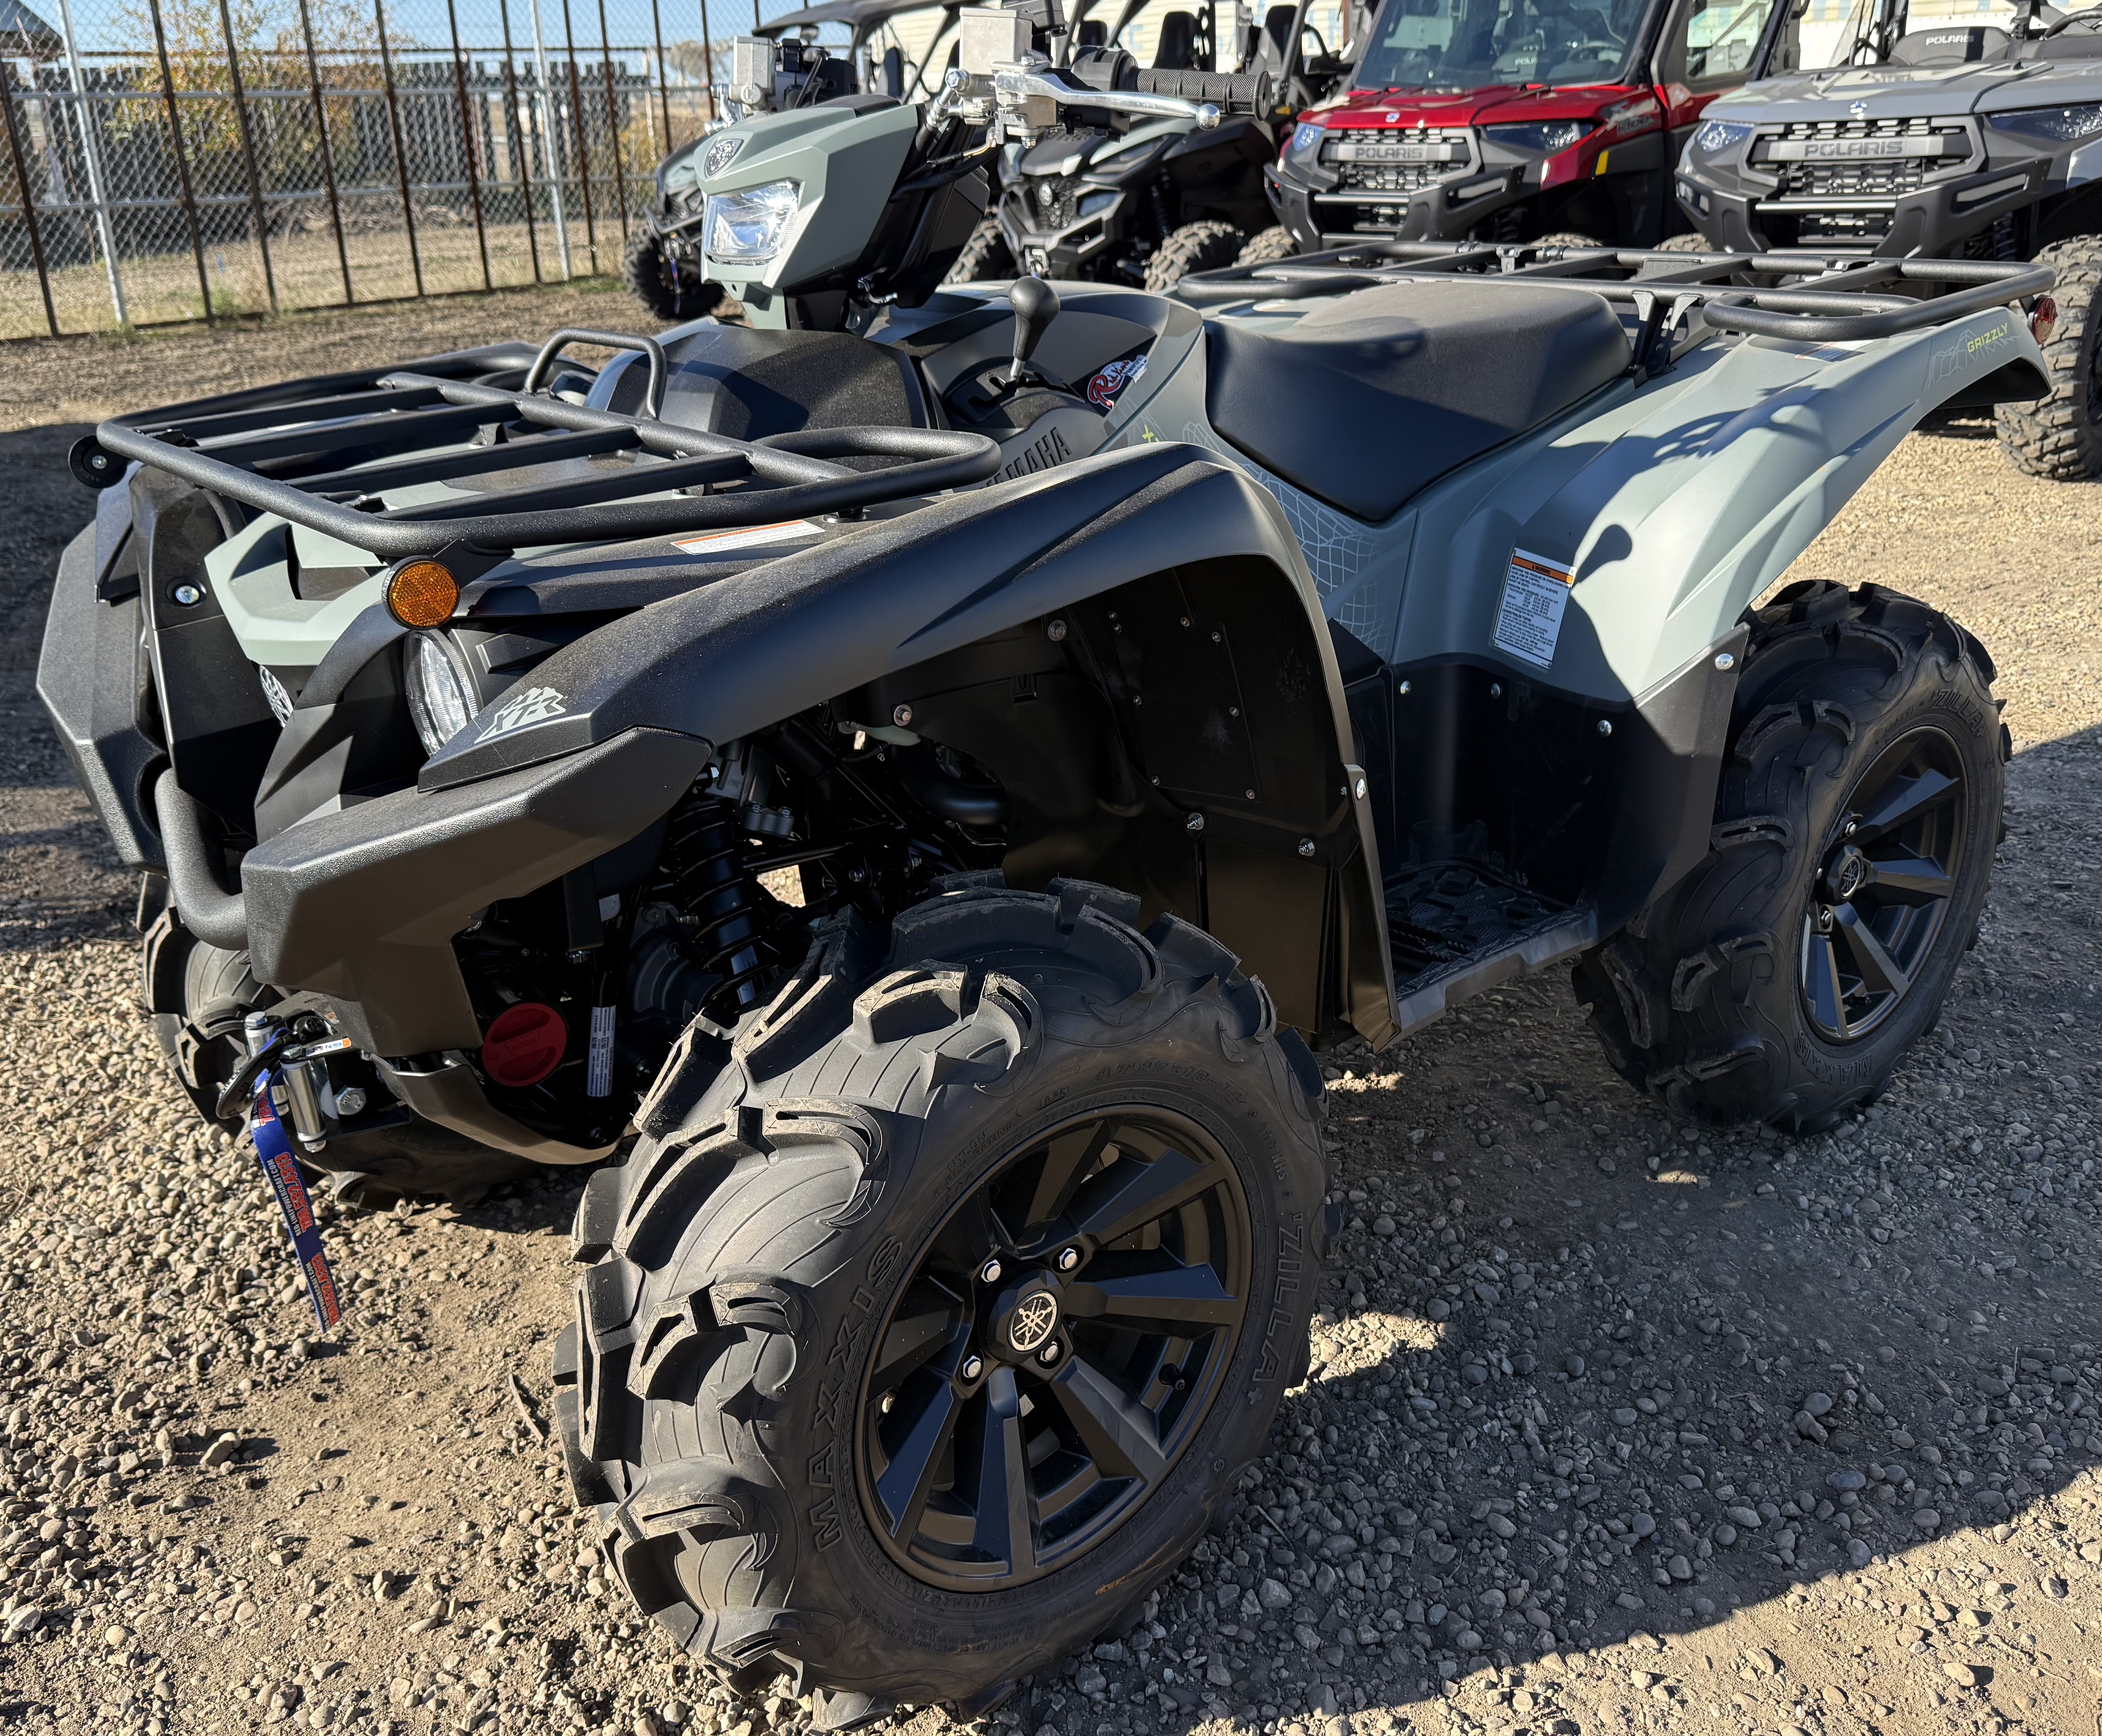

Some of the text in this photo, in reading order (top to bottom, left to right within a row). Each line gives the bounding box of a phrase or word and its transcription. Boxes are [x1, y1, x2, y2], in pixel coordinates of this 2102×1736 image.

[1925, 34, 1974, 46] POLARIS
[1355, 145, 1423, 159] POLARIS
[1804, 141, 1903, 158] POLARIS
[1967, 323, 2008, 353] GRIZZLY
[982, 427, 1072, 488] MAHA
[1272, 1153, 1288, 1182] NHS
[266, 1158, 302, 1236] RED-LINEPOWERCRAFT.COM
[807, 1234, 903, 1551] MAXXIS
